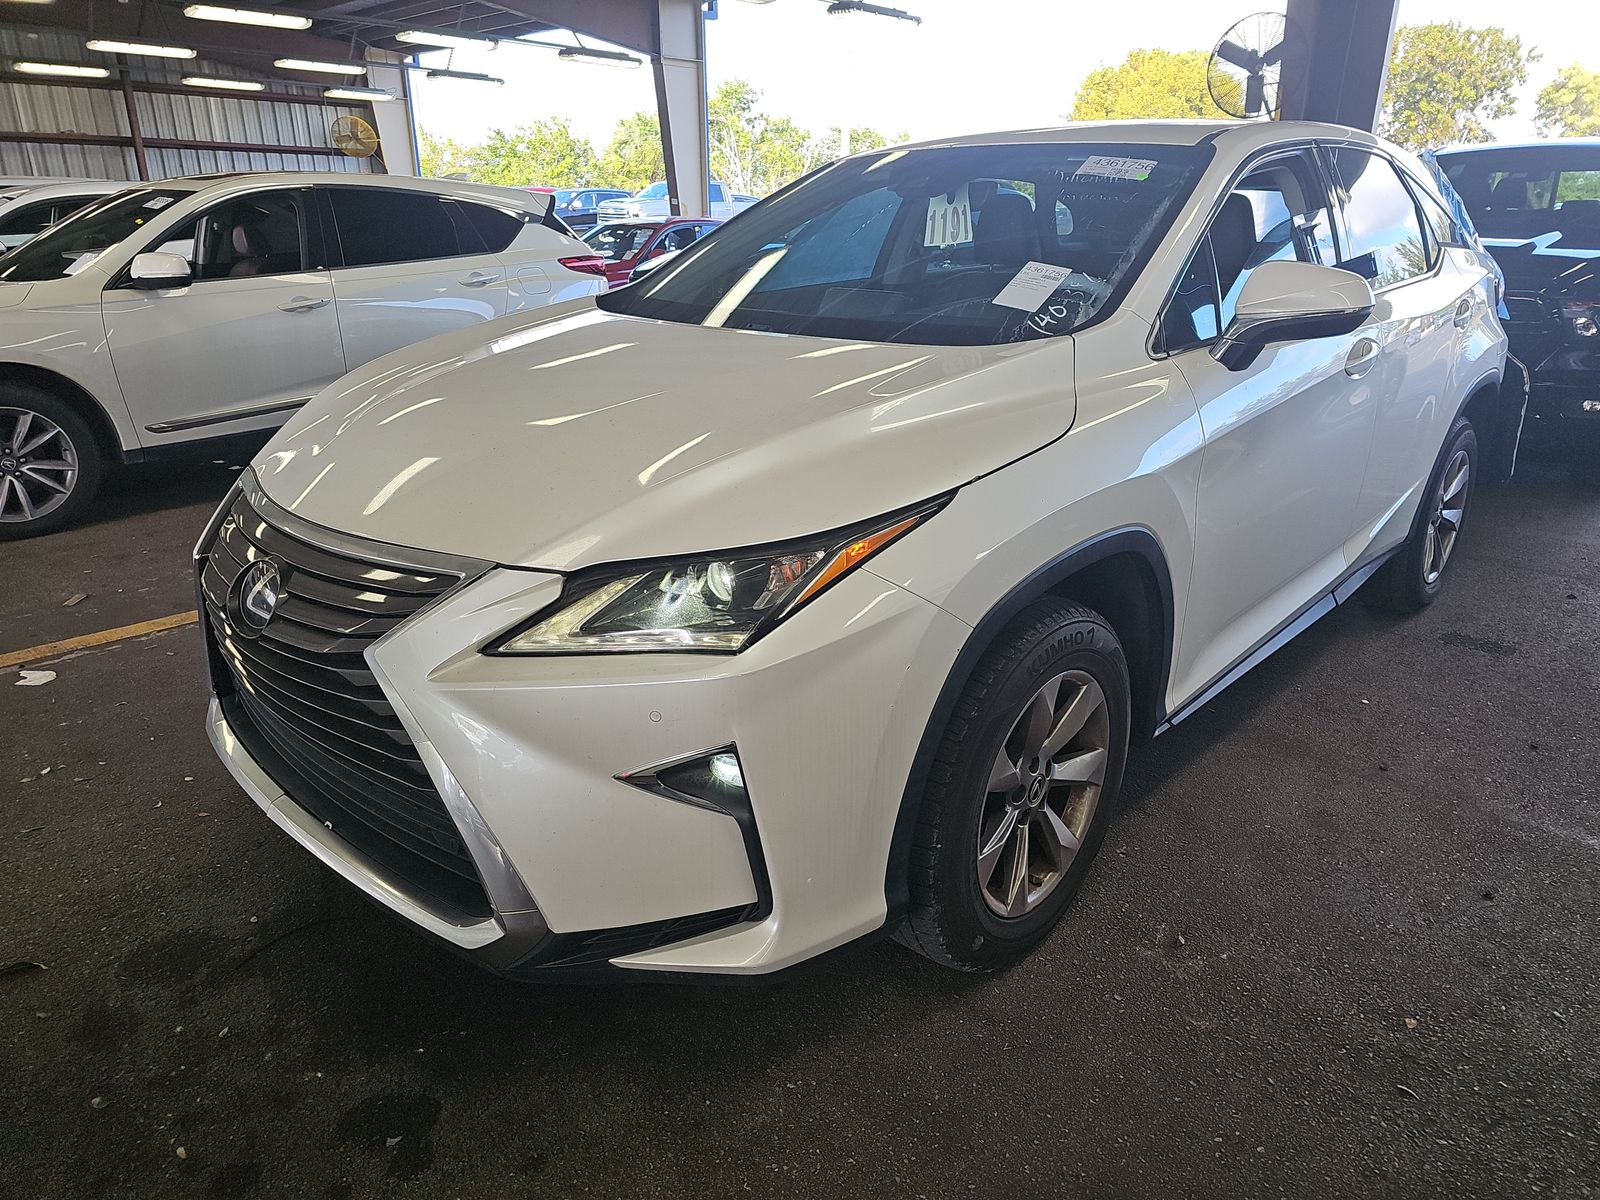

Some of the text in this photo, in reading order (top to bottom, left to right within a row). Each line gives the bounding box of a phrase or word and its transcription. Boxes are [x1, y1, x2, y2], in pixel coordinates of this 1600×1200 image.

[1093, 158, 1155, 171] 4361756
[929, 204, 969, 245] 1191
[1026, 265, 1068, 279] 4361756
